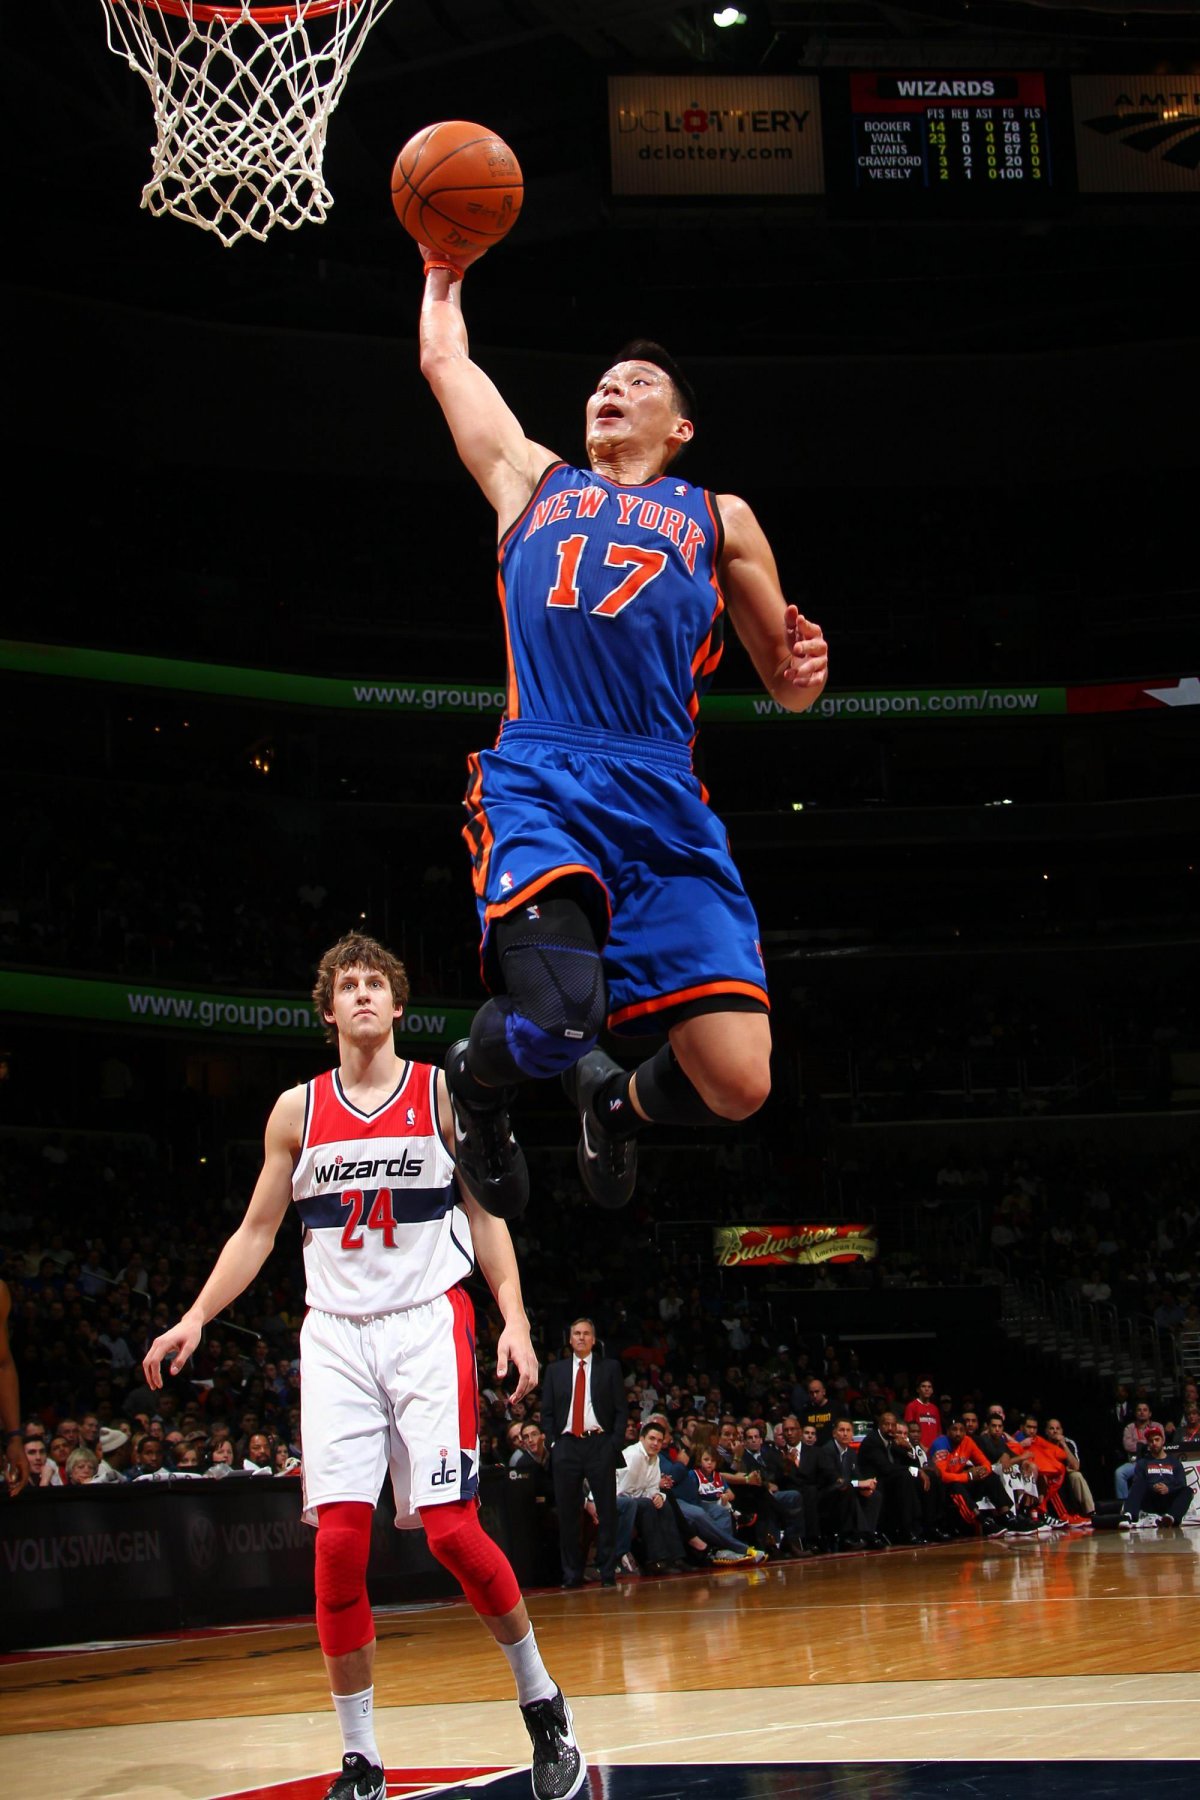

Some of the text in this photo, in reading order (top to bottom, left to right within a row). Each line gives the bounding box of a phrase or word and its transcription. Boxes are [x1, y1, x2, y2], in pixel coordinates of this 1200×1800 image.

[897, 81, 995, 96] WIZARDS
[927, 108, 1041, 119] PTS REB AST FG FLS
[864, 121, 1036, 132] BOOKER 14 5 0 78 1
[871, 133, 1038, 143] WALL 23 0 4 56 2
[639, 145, 793, 162] dclottery.com
[870, 144, 1039, 155] EVANS 7 0 0 67 0
[858, 156, 1040, 166] CRAWFORD 3 2 0 20 0
[869, 169, 911, 179] VESELY
[940, 169, 949, 179] 2
[965, 169, 972, 179] 1
[1033, 169, 1041, 179] 3
[523, 485, 706, 576] NEW YORK
[546, 533, 668, 618] 17
[353, 686, 506, 711] www.groupo
[315, 1148, 425, 1184] wizards
[340, 1186, 399, 1249] 24
[719, 1227, 838, 1267] Budweiser
[222, 1521, 316, 1555] VOLKSWA
[3, 1530, 161, 1573] VOLKSWAGEN
